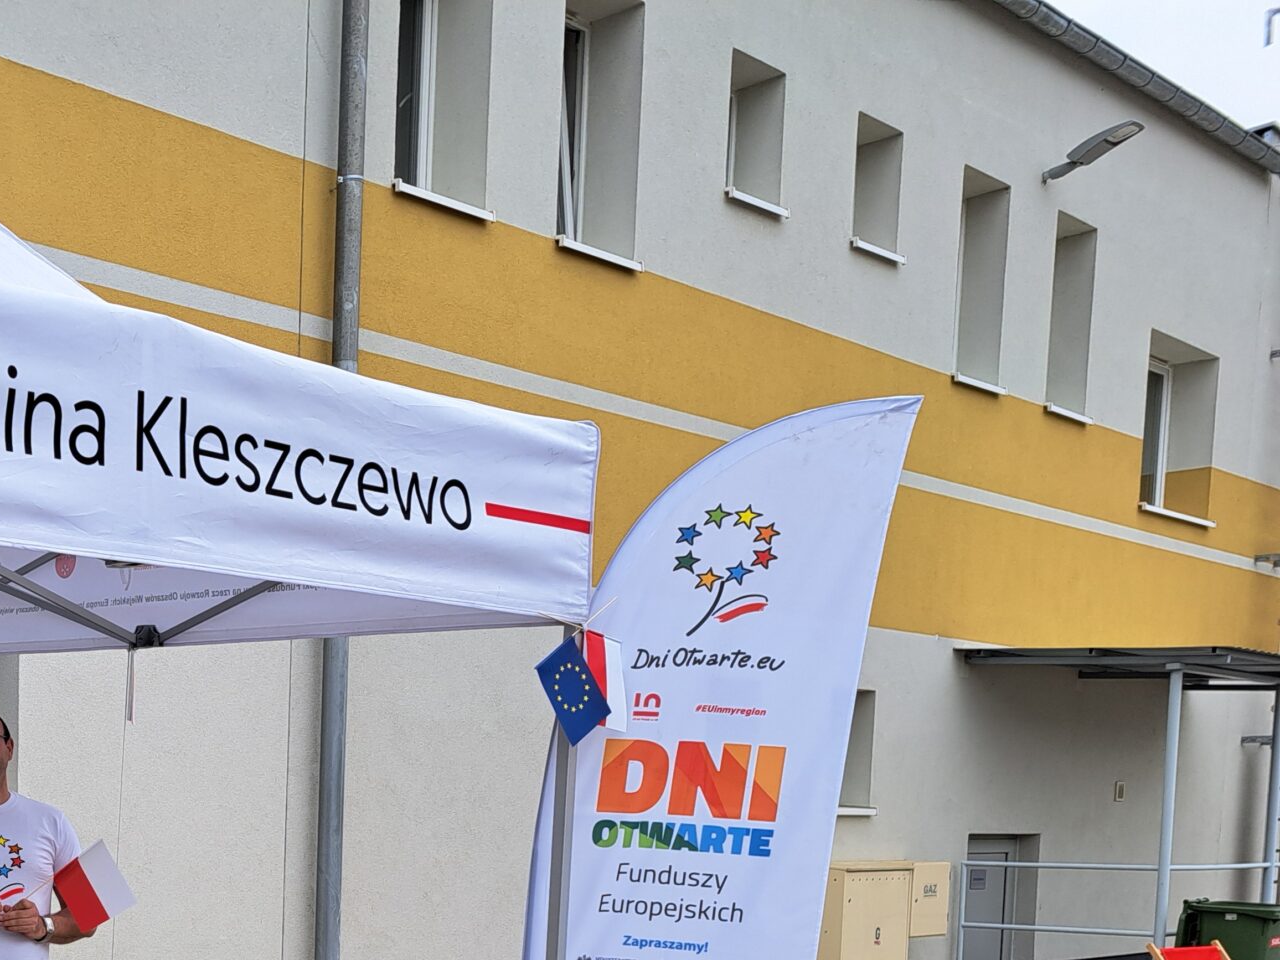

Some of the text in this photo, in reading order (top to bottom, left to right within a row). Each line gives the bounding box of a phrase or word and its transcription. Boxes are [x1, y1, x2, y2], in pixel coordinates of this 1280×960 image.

[135, 389, 473, 531] Kleszczewo
[630, 647, 786, 672] Dni Otwarte.eu
[695, 704, 767, 717] #EUinmyregion
[596, 738, 788, 823] DNI
[591, 819, 775, 858] OTWARTE
[615, 862, 729, 895] Funduszy
[923, 884, 938, 895] GAZ
[598, 893, 745, 924] Europejskich
[622, 935, 710, 955] Zapraszamy!
